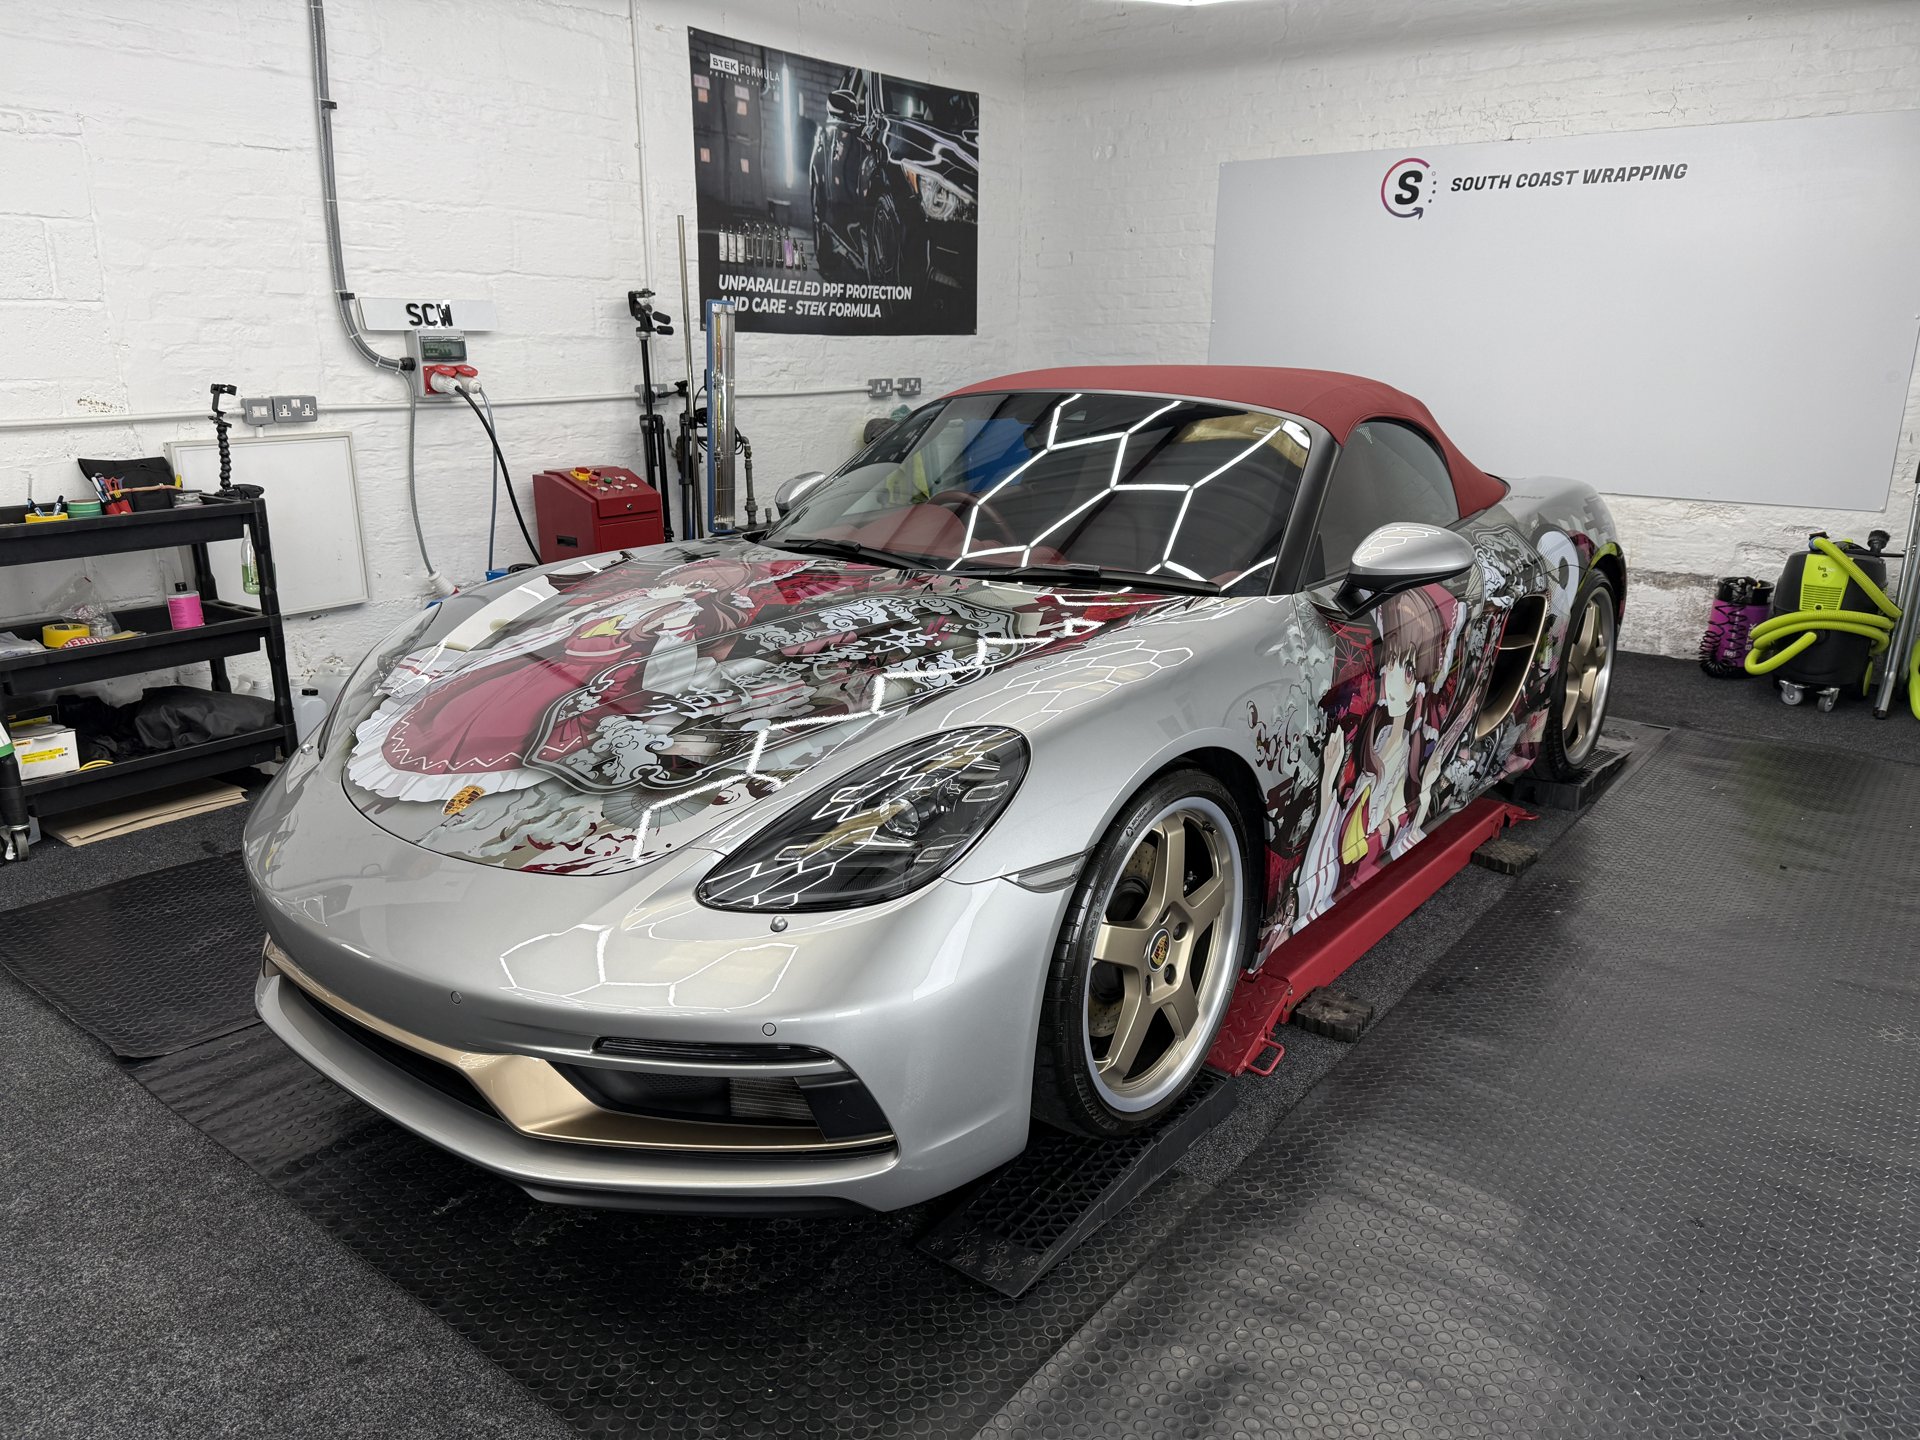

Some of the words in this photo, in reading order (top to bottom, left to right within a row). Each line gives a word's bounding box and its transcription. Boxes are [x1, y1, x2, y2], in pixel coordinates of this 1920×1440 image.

[712, 57, 737, 72] STEK
[740, 64, 780, 83] FORMULA
[1450, 174, 1513, 192] SOUTH
[1516, 169, 1579, 189] COAST
[1582, 163, 1688, 185] WRAPPING
[718, 274, 821, 297] UNPARALLELED
[822, 283, 845, 299] PPF
[846, 284, 913, 301] PROTECTION
[405, 302, 454, 327] SCW
[752, 299, 786, 314] CARE
[795, 301, 829, 317] STEK
[828, 302, 882, 319] FORMULA
